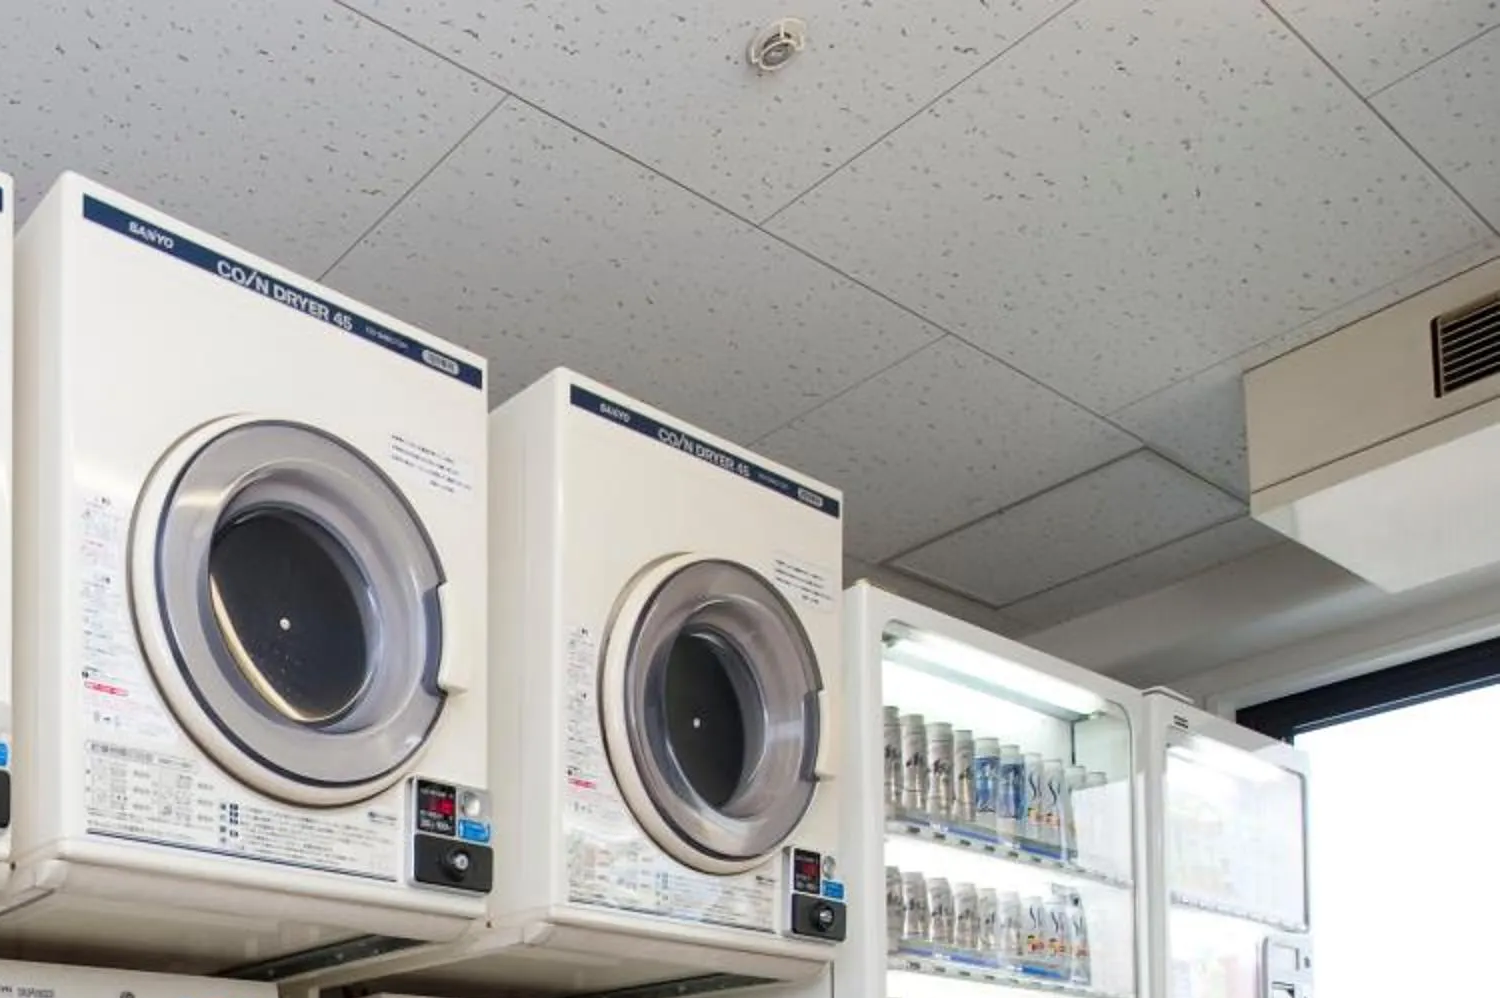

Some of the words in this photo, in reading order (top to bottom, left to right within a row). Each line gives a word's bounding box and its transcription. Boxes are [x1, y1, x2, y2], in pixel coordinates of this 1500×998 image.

[128, 220, 175, 250] SANYO
[273, 283, 331, 321] DRYER
[332, 310, 354, 332] 45
[599, 402, 631, 424] SANYO
[695, 445, 735, 471] DRYER
